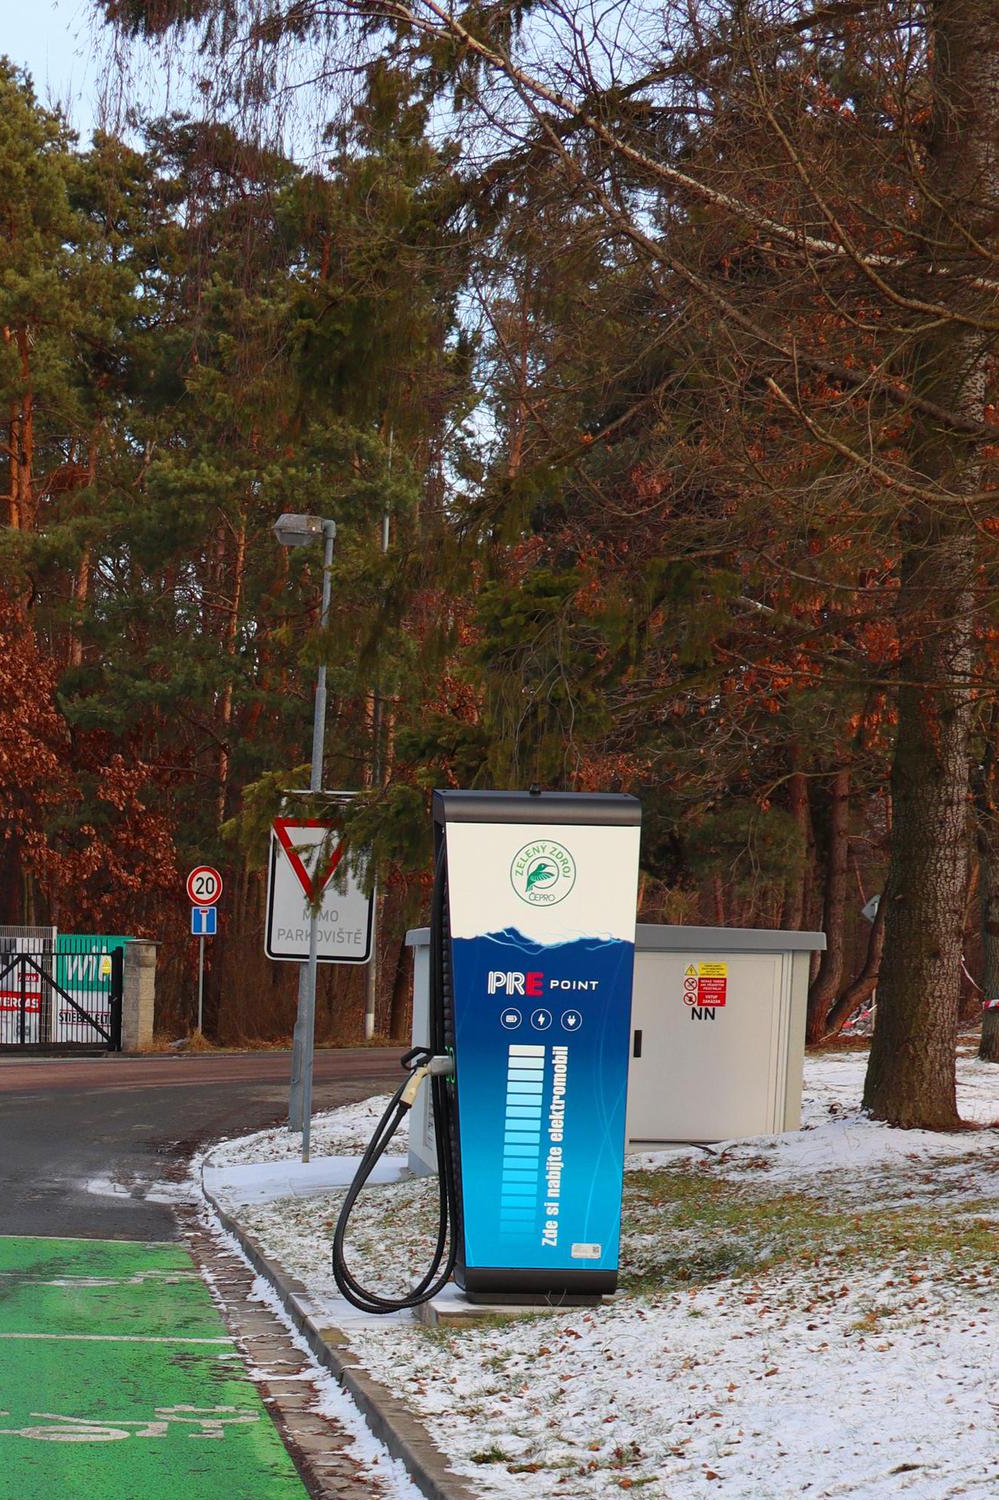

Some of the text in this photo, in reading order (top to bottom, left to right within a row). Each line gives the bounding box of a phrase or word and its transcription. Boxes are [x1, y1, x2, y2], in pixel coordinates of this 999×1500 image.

[515, 843, 571, 878] ZELENÝ ZDROJ
[195, 877, 215, 895] 20
[529, 892, 556, 901] ČEPRO
[302, 910, 339, 922] MMO
[277, 928, 363, 944] PARKOVIŠTĚ
[488, 971, 599, 996] PRE POINT
[691, 1007, 716, 1020] NN
[548, 1046, 569, 1142] elektromobil
[544, 1202, 560, 1216] si
[542, 1220, 558, 1247] Zde
